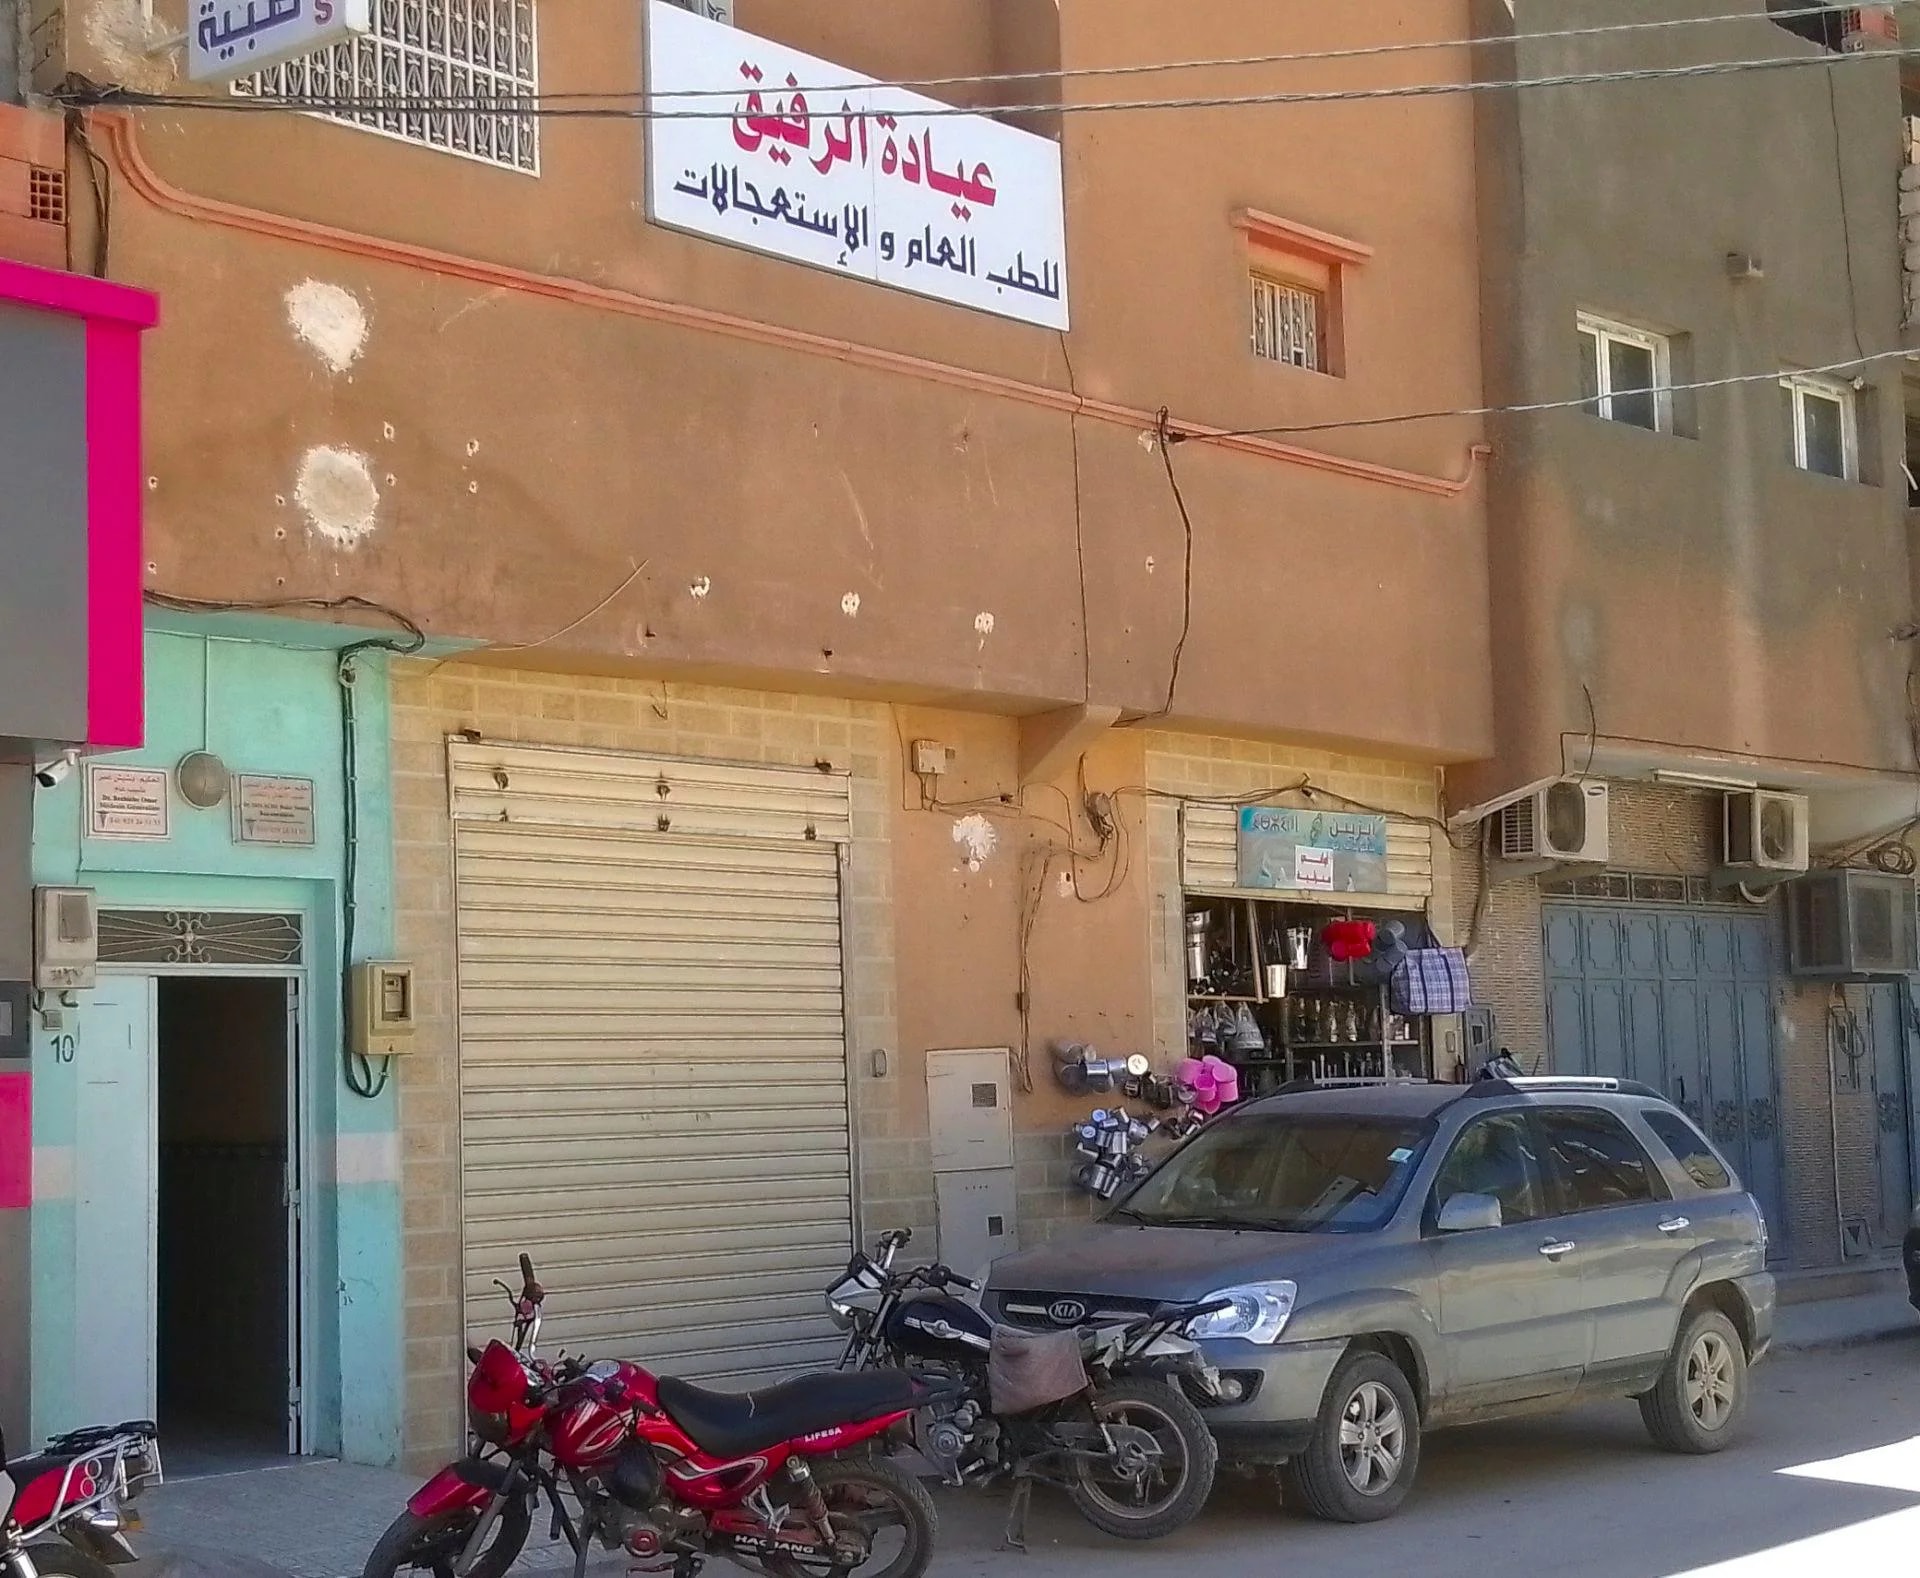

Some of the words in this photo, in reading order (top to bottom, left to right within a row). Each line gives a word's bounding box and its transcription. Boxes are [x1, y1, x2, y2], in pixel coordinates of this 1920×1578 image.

[732, 61, 868, 175] الرفيق
[876, 115, 997, 221] عيادة
[673, 162, 868, 267] الإستعجالات
[879, 231, 896, 262] و
[904, 225, 976, 277] العام
[986, 252, 1059, 300] للطب
[51, 1034, 74, 1064] 10
[1054, 1304, 1078, 1318] KIA
